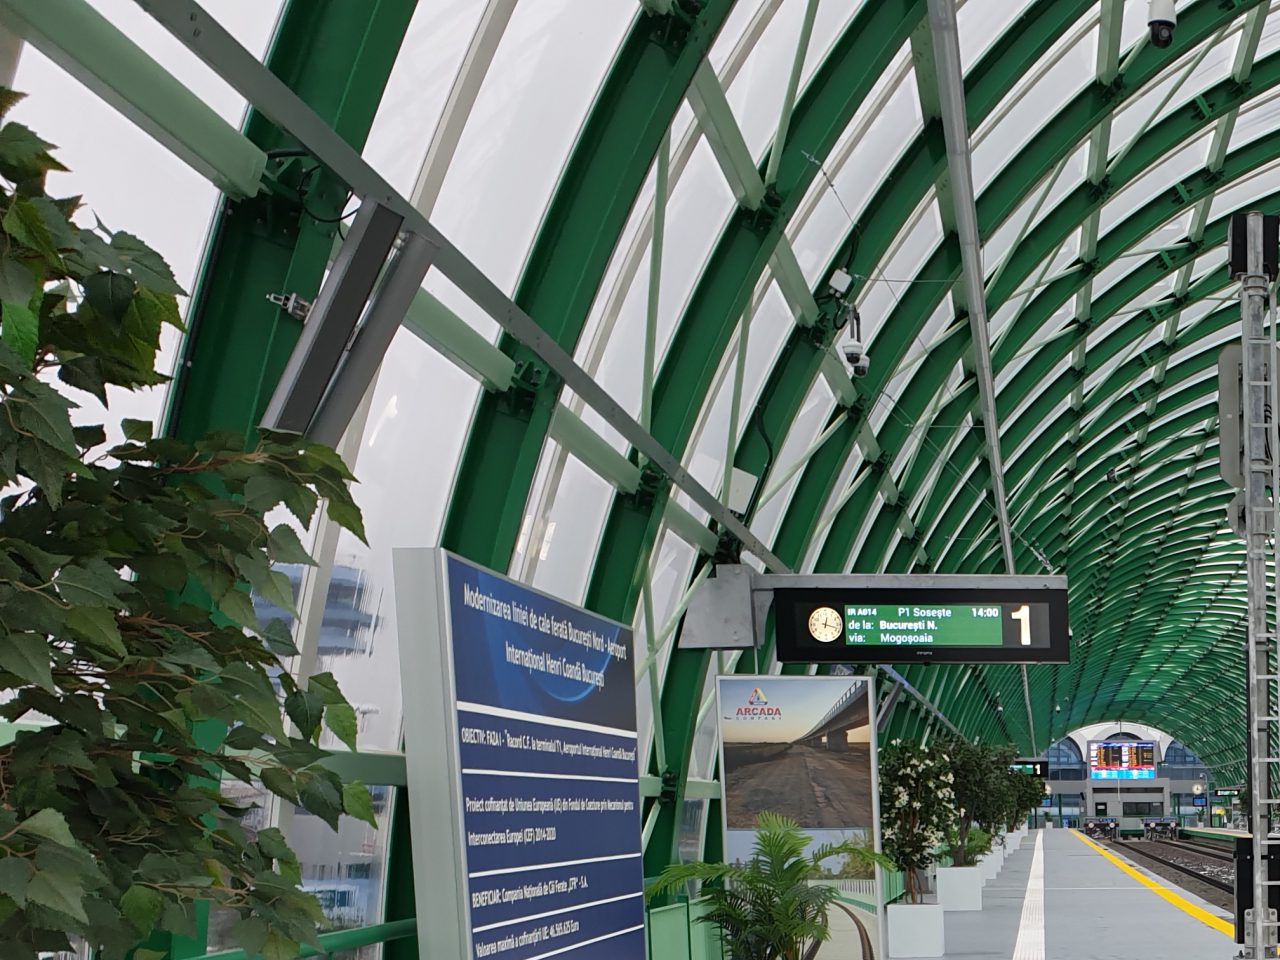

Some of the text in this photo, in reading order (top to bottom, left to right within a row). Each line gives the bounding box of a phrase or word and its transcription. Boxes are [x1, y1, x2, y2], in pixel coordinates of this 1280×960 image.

[464, 583, 511, 620] Modernizarea
[512, 600, 529, 626] liniei
[529, 608, 537, 629] de
[538, 613, 551, 634] cale
[551, 615, 568, 640] ferată
[592, 632, 604, 652] Nord
[607, 637, 627, 661] Aeroport
[847, 608, 857, 616] IR
[898, 607, 910, 617] P1
[971, 607, 999, 617] 14:00
[1011, 605, 1031, 646] 1
[848, 620, 861, 630] de
[862, 620, 874, 630] la:
[927, 621, 938, 630] N.
[848, 633, 866, 643] via:
[546, 653, 562, 675] Henri
[562, 658, 582, 680] Coandă
[736, 707, 782, 716] ARCADA
[486, 730, 499, 746] FAZA
[1034, 763, 1041, 775] 1
[466, 797, 484, 812] Proiect
[509, 797, 515, 811] de
[581, 798, 586, 811] de
[468, 830, 506, 846] Interconectarea
[472, 888, 501, 908] BENEFICIAR:
[501, 886, 524, 904] Compania
[543, 881, 549, 896] de
[475, 941, 497, 958] Valoarea
[571, 919, 580, 933] Euro
